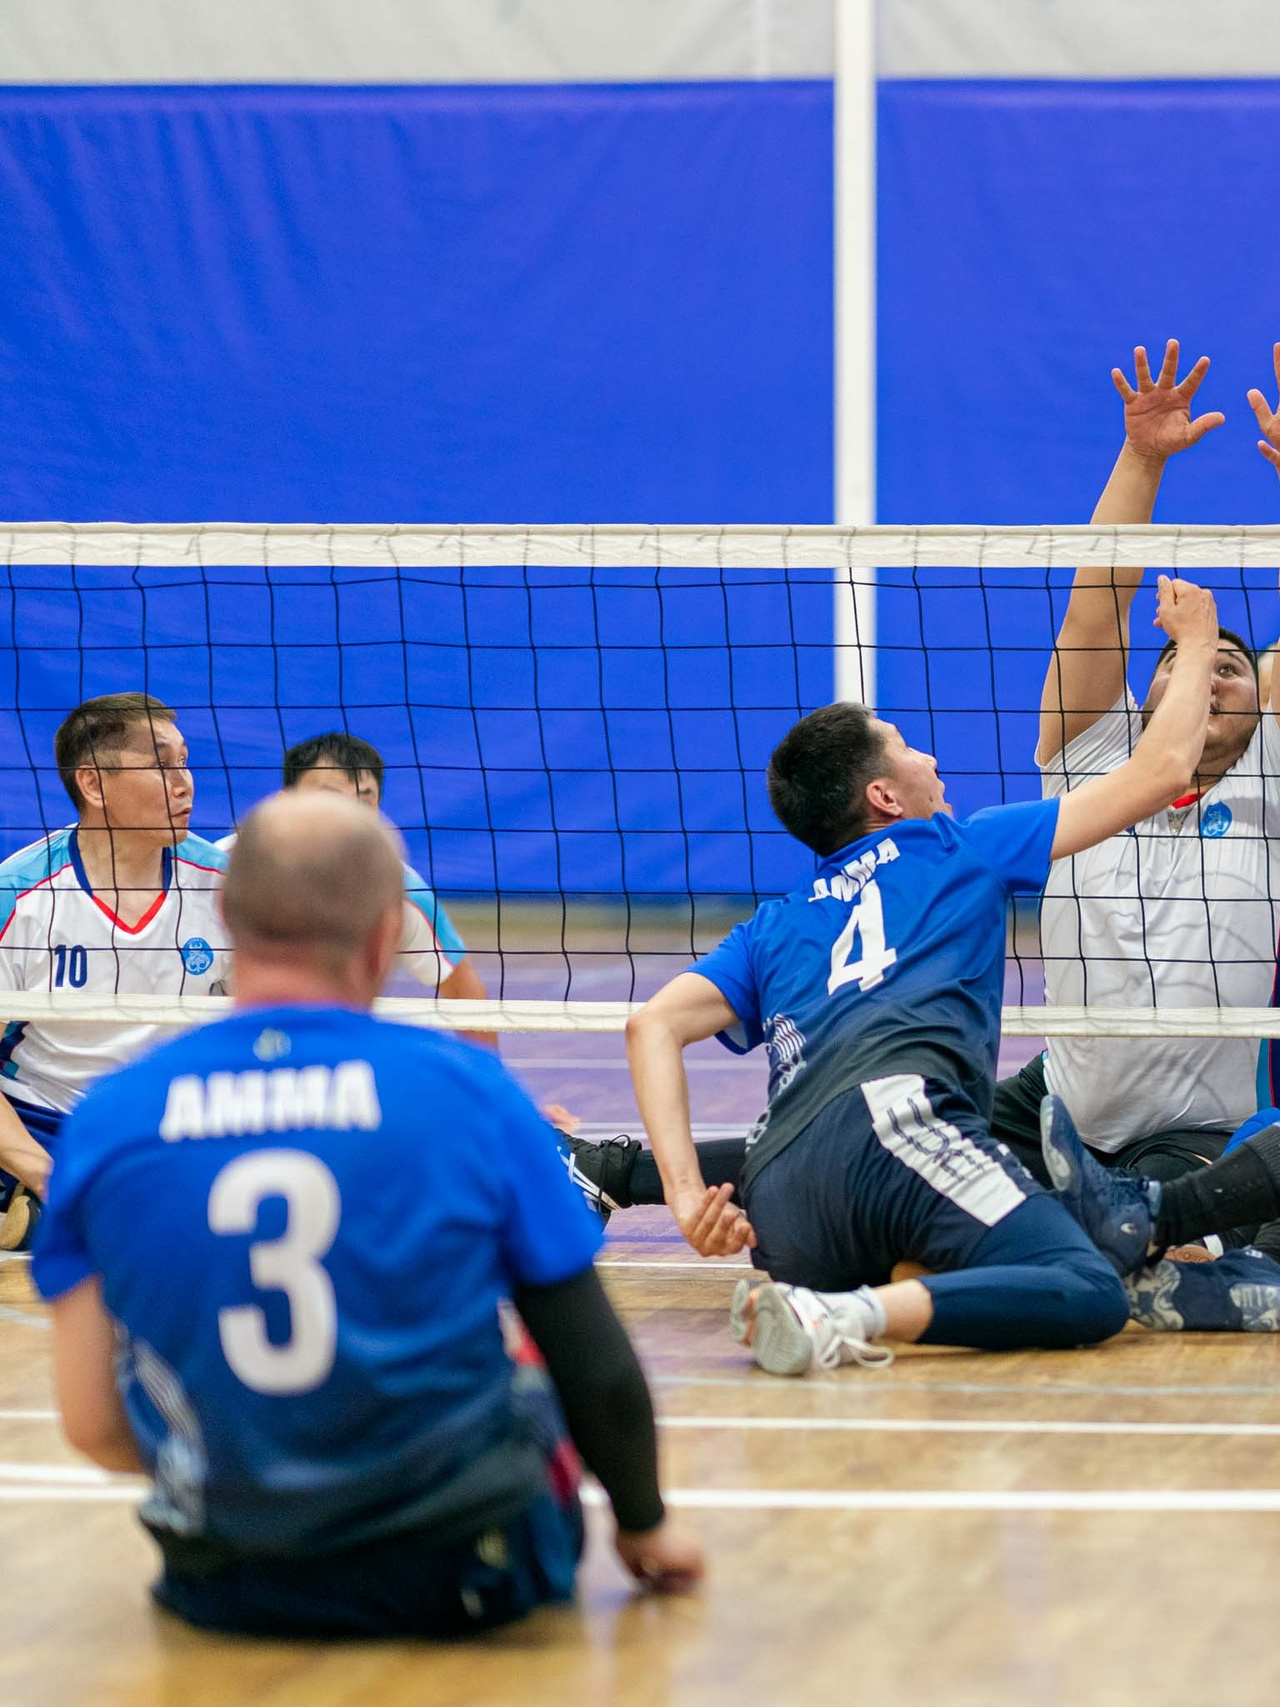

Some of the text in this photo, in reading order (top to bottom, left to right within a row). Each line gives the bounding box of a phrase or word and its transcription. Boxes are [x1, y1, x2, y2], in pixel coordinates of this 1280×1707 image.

[54, 944, 88, 989] 10
[826, 878, 898, 996] 4
[207, 1149, 341, 1393] 3
